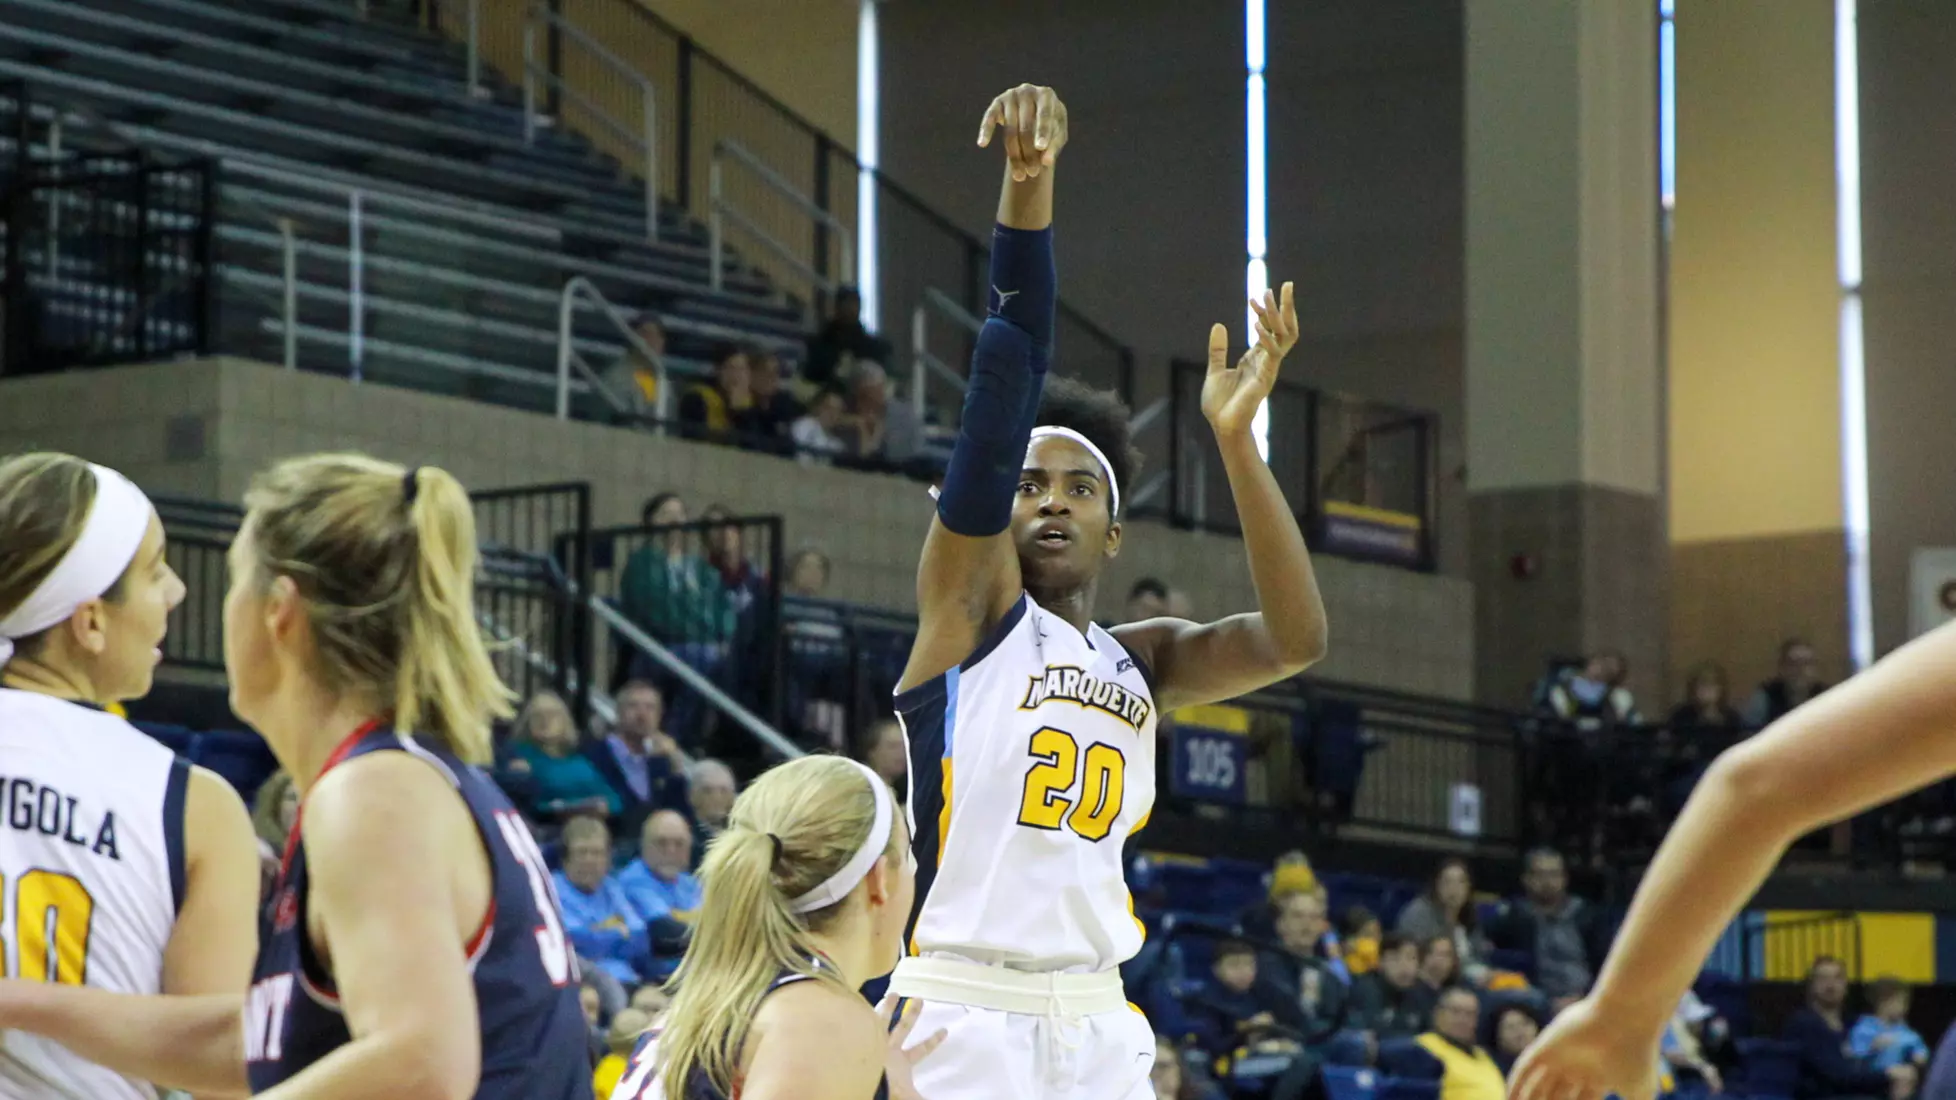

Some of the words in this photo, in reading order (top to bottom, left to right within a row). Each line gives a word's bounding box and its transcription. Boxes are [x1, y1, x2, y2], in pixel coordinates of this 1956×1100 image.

[1018, 664, 1150, 735] MARQUETTE
[1017, 725, 1126, 843] 20
[1186, 737, 1236, 790] 105
[0, 774, 120, 860] GOLA
[0, 867, 94, 986] 0
